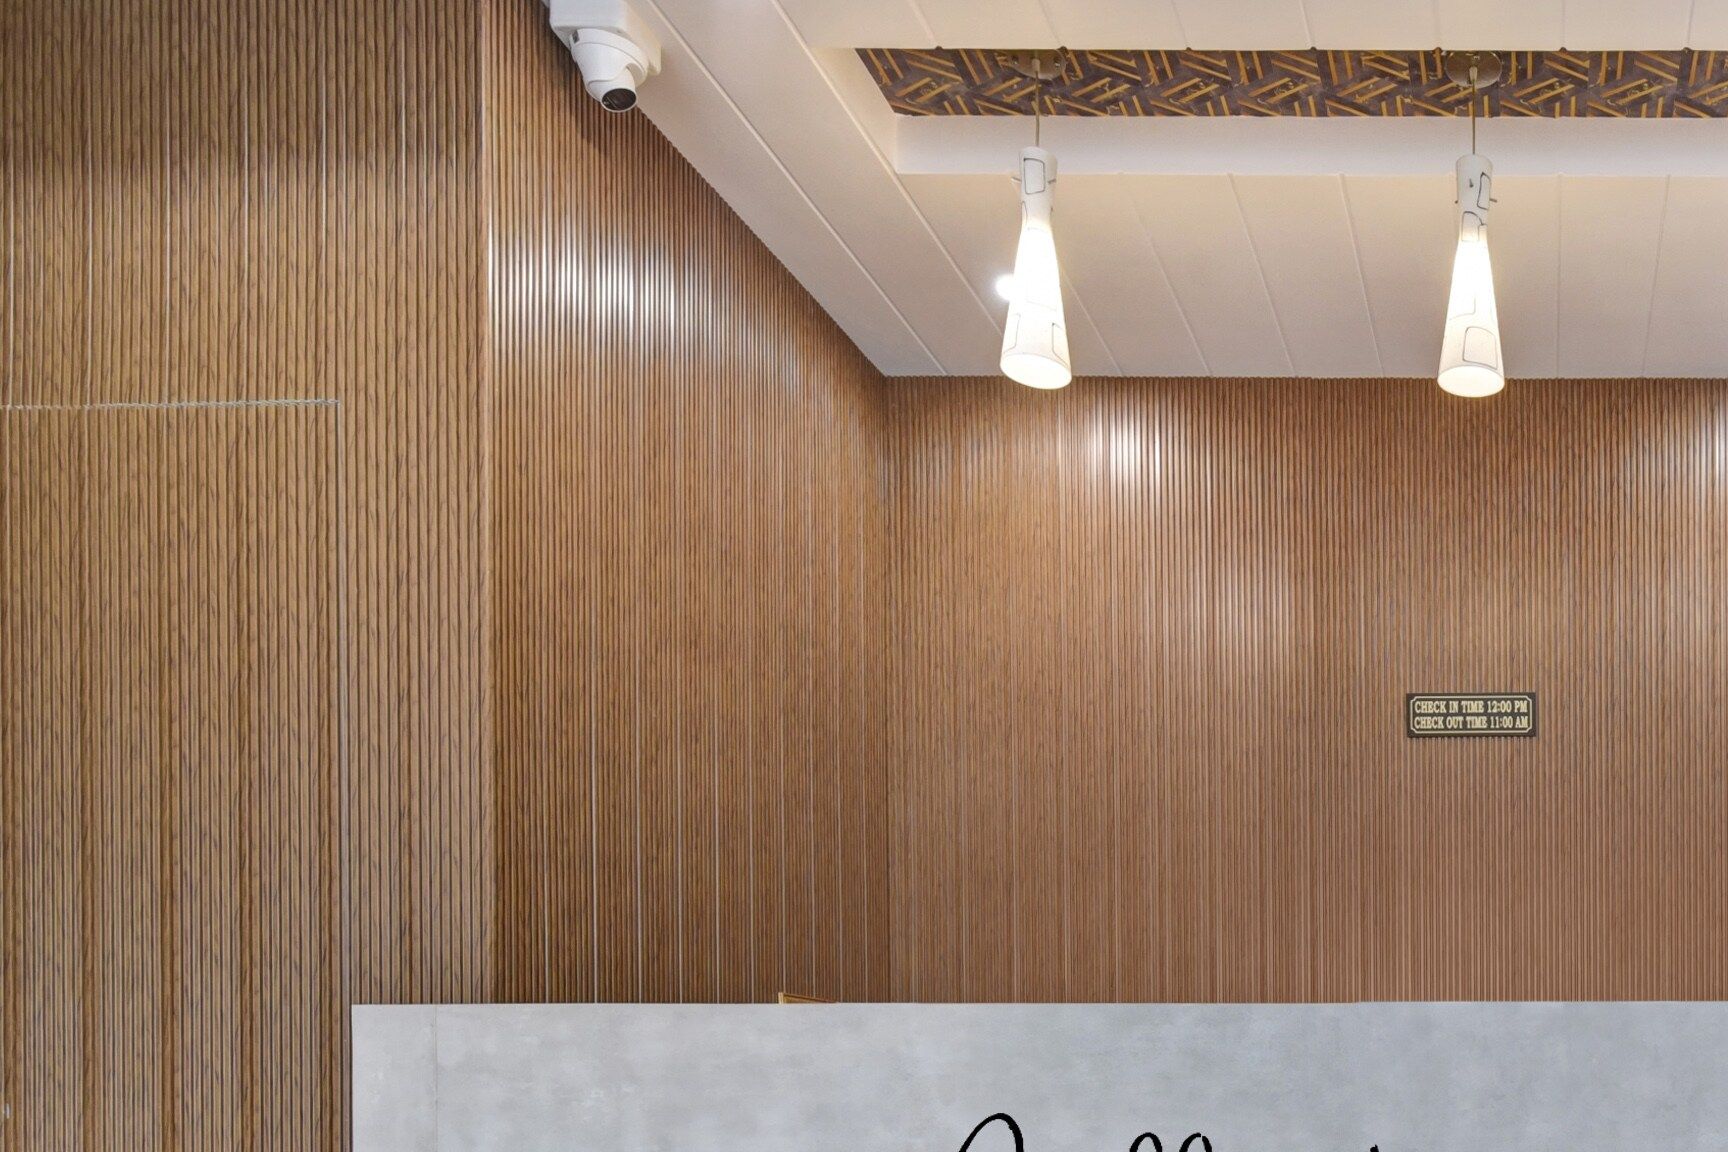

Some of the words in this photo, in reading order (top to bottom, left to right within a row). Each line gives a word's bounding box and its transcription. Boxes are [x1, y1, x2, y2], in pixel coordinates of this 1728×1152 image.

[1415, 700, 1447, 713] CHECK
[1449, 700, 1459, 713] IN
[1461, 700, 1484, 713] TIME
[1487, 700, 1512, 713] 12:00
[1514, 700, 1528, 713] PM
[1414, 716, 1444, 729] CHECK
[1446, 716, 1464, 729] OUT
[1466, 716, 1487, 729] TIME
[1490, 716, 1513, 729] 11:00
[1515, 715, 1528, 728] AM
